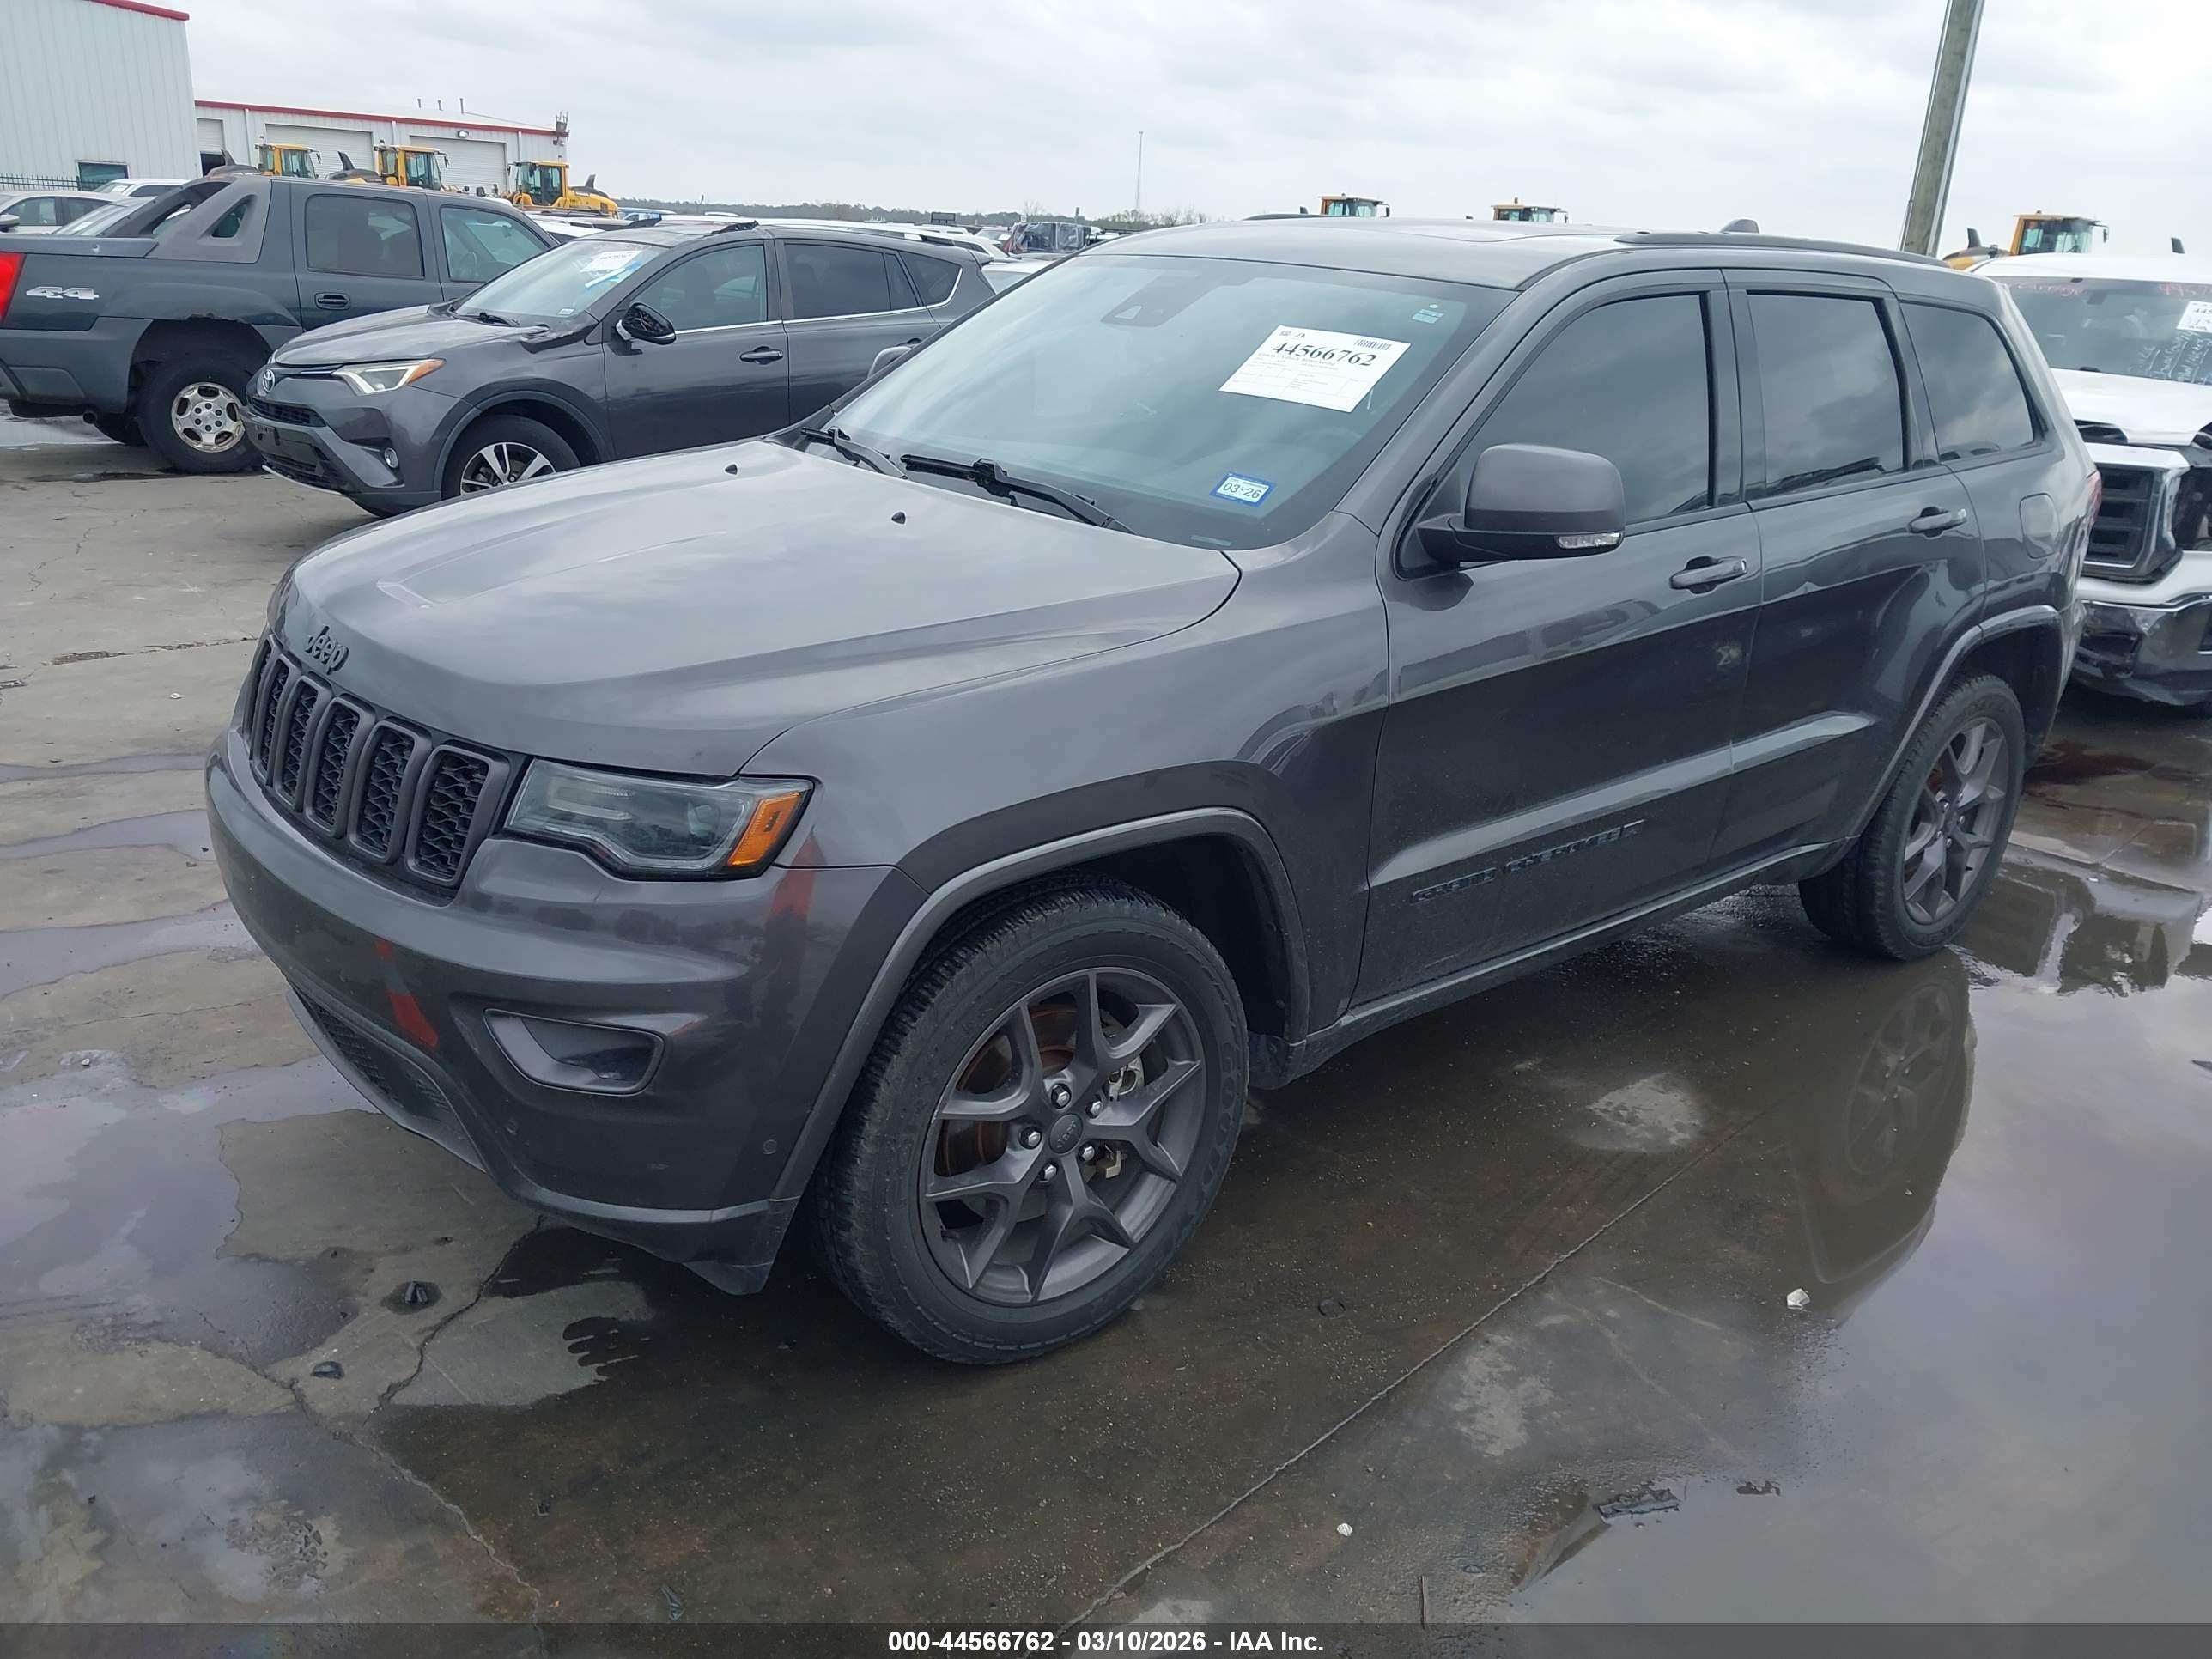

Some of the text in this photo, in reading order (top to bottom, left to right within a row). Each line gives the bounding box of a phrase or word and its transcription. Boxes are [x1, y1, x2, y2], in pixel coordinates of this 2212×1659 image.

[1272, 342, 1377, 366] 44566762
[1222, 483, 1241, 493] 03
[1243, 487, 1262, 499] 26
[306, 625, 349, 675] Jeep
